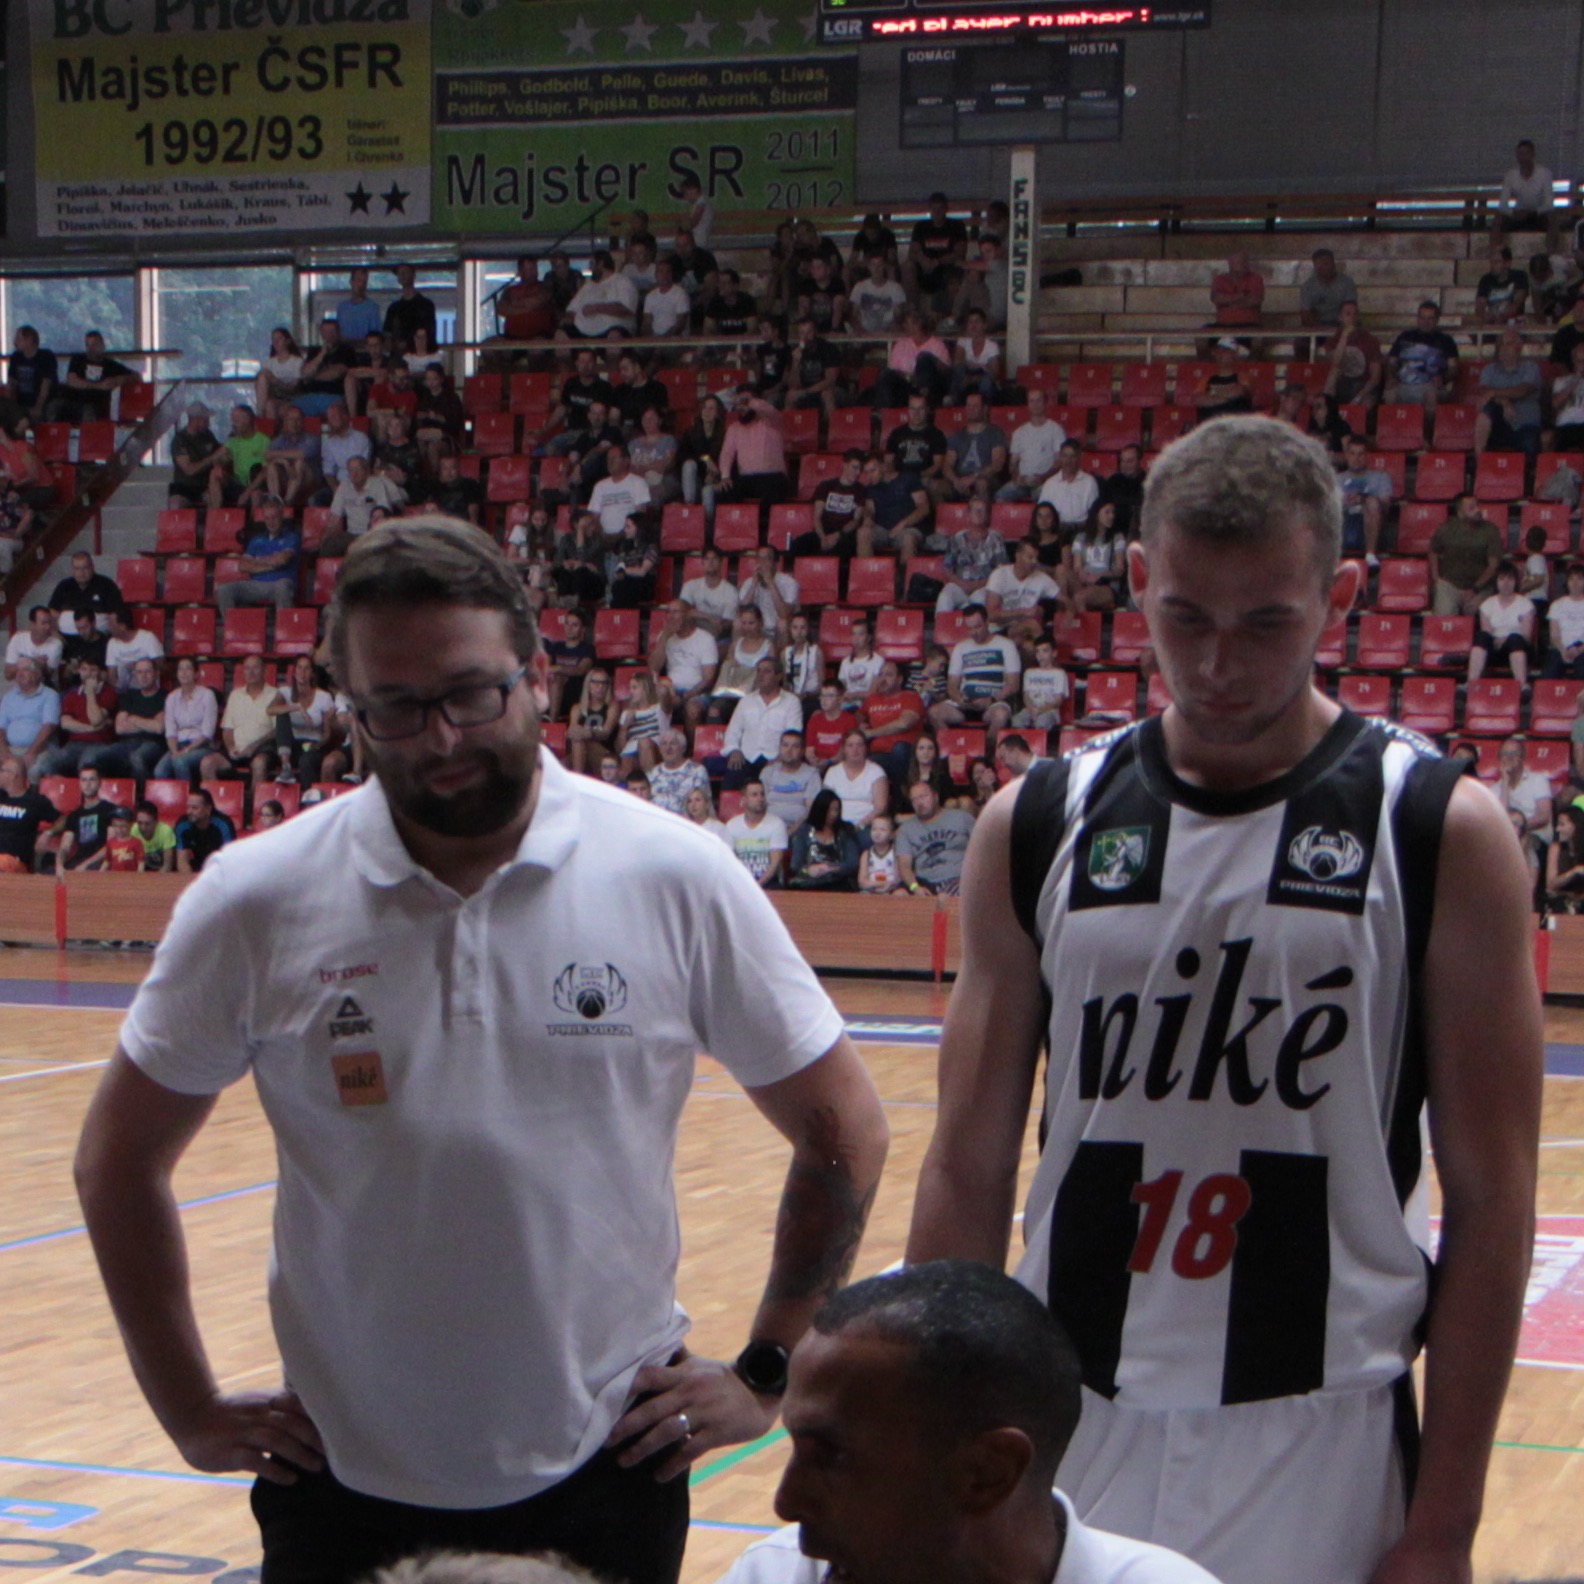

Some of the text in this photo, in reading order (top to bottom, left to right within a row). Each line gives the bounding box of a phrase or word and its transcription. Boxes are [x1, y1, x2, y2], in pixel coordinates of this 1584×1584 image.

[53, 0, 133, 37] BC
[824, 19, 863, 36] LGR
[1069, 42, 1119, 56] HOSTIA
[57, 35, 404, 111] Majster ČSFR
[134, 115, 323, 166] 1992/93
[766, 128, 840, 161] 2011
[446, 145, 744, 219] Majster SR
[766, 179, 844, 209] 2012
[1279, 879, 1361, 899] PRIEVIDZA
[319, 961, 379, 985] brose
[329, 1018, 374, 1038] PEAK
[1079, 937, 1354, 1110] niké
[340, 1066, 379, 1090] niké
[1125, 1170, 1252, 1279] 18
